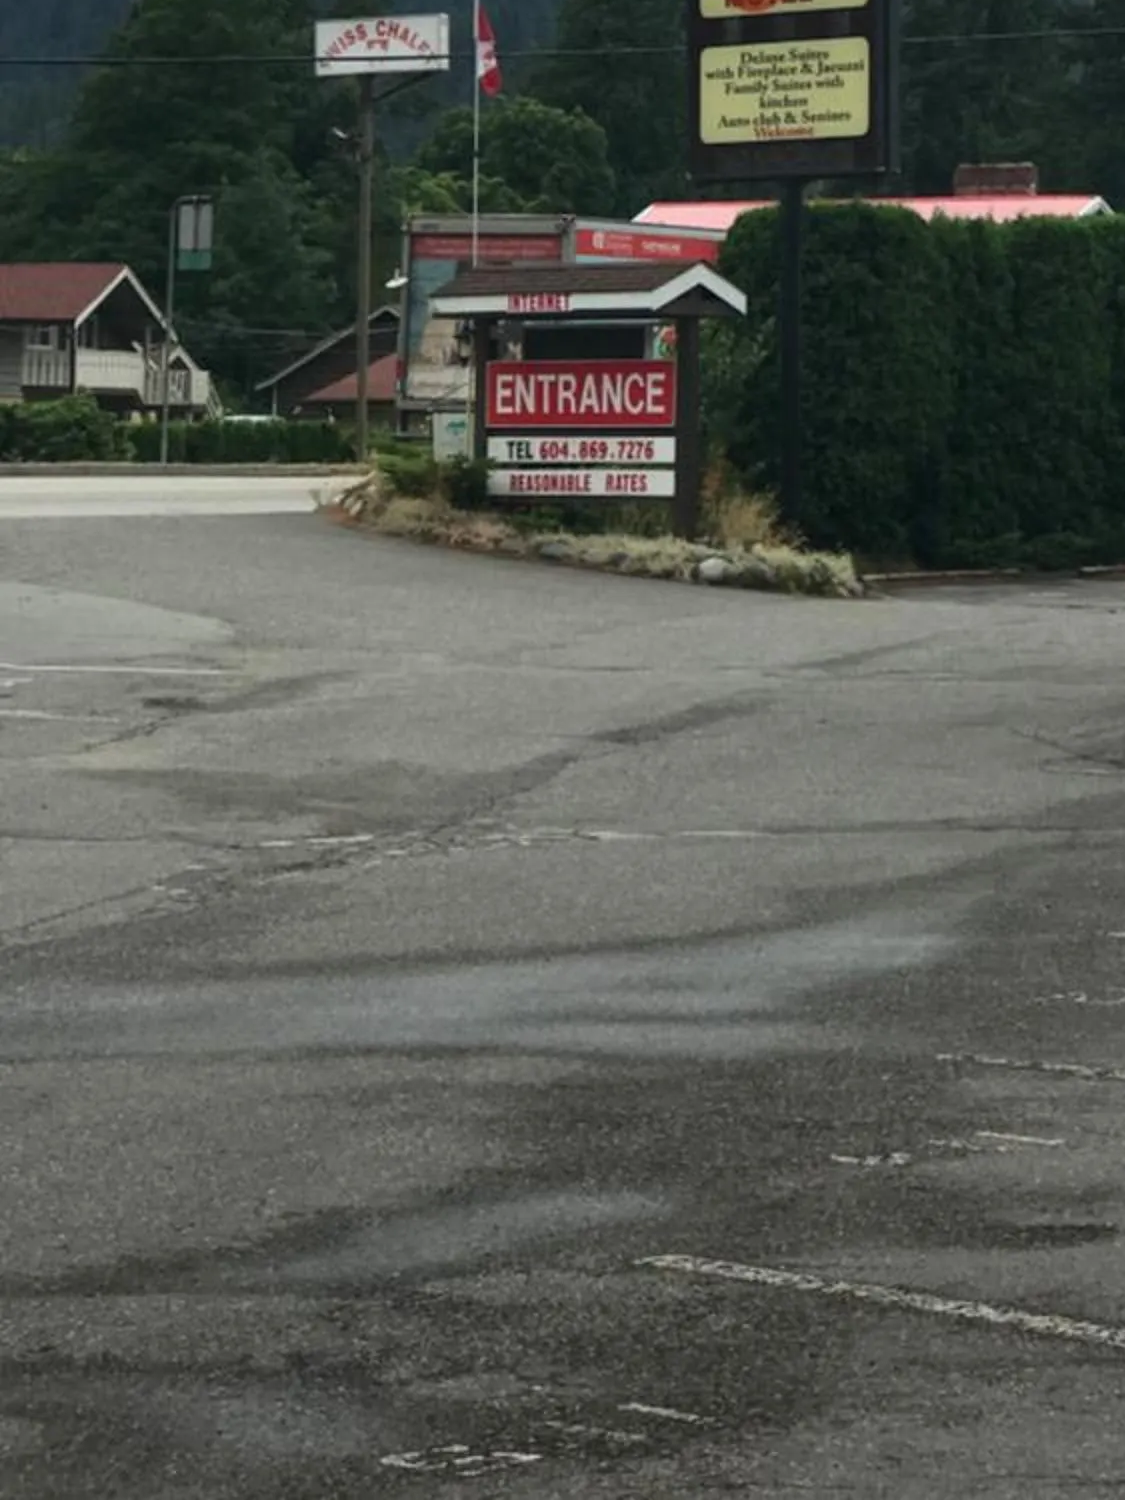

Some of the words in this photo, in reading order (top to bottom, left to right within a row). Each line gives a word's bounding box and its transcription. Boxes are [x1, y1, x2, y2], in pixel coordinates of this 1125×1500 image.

[789, 48, 829, 61] Suites
[706, 67, 734, 80] with
[738, 62, 797, 81] Fireplace
[800, 62, 813, 74] &
[816, 58, 865, 76] Jacuzzi
[724, 80, 768, 96] Family
[772, 78, 812, 91] Suites
[816, 75, 844, 88] with
[784, 111, 797, 124] &
[753, 125, 814, 138] Welcome
[495, 372, 667, 415] ENTRANCE
[507, 441, 534, 460] TEL
[539, 440, 655, 460] 604.869.7276
[509, 474, 592, 493] REASONABLE
[605, 473, 648, 492] RATES
